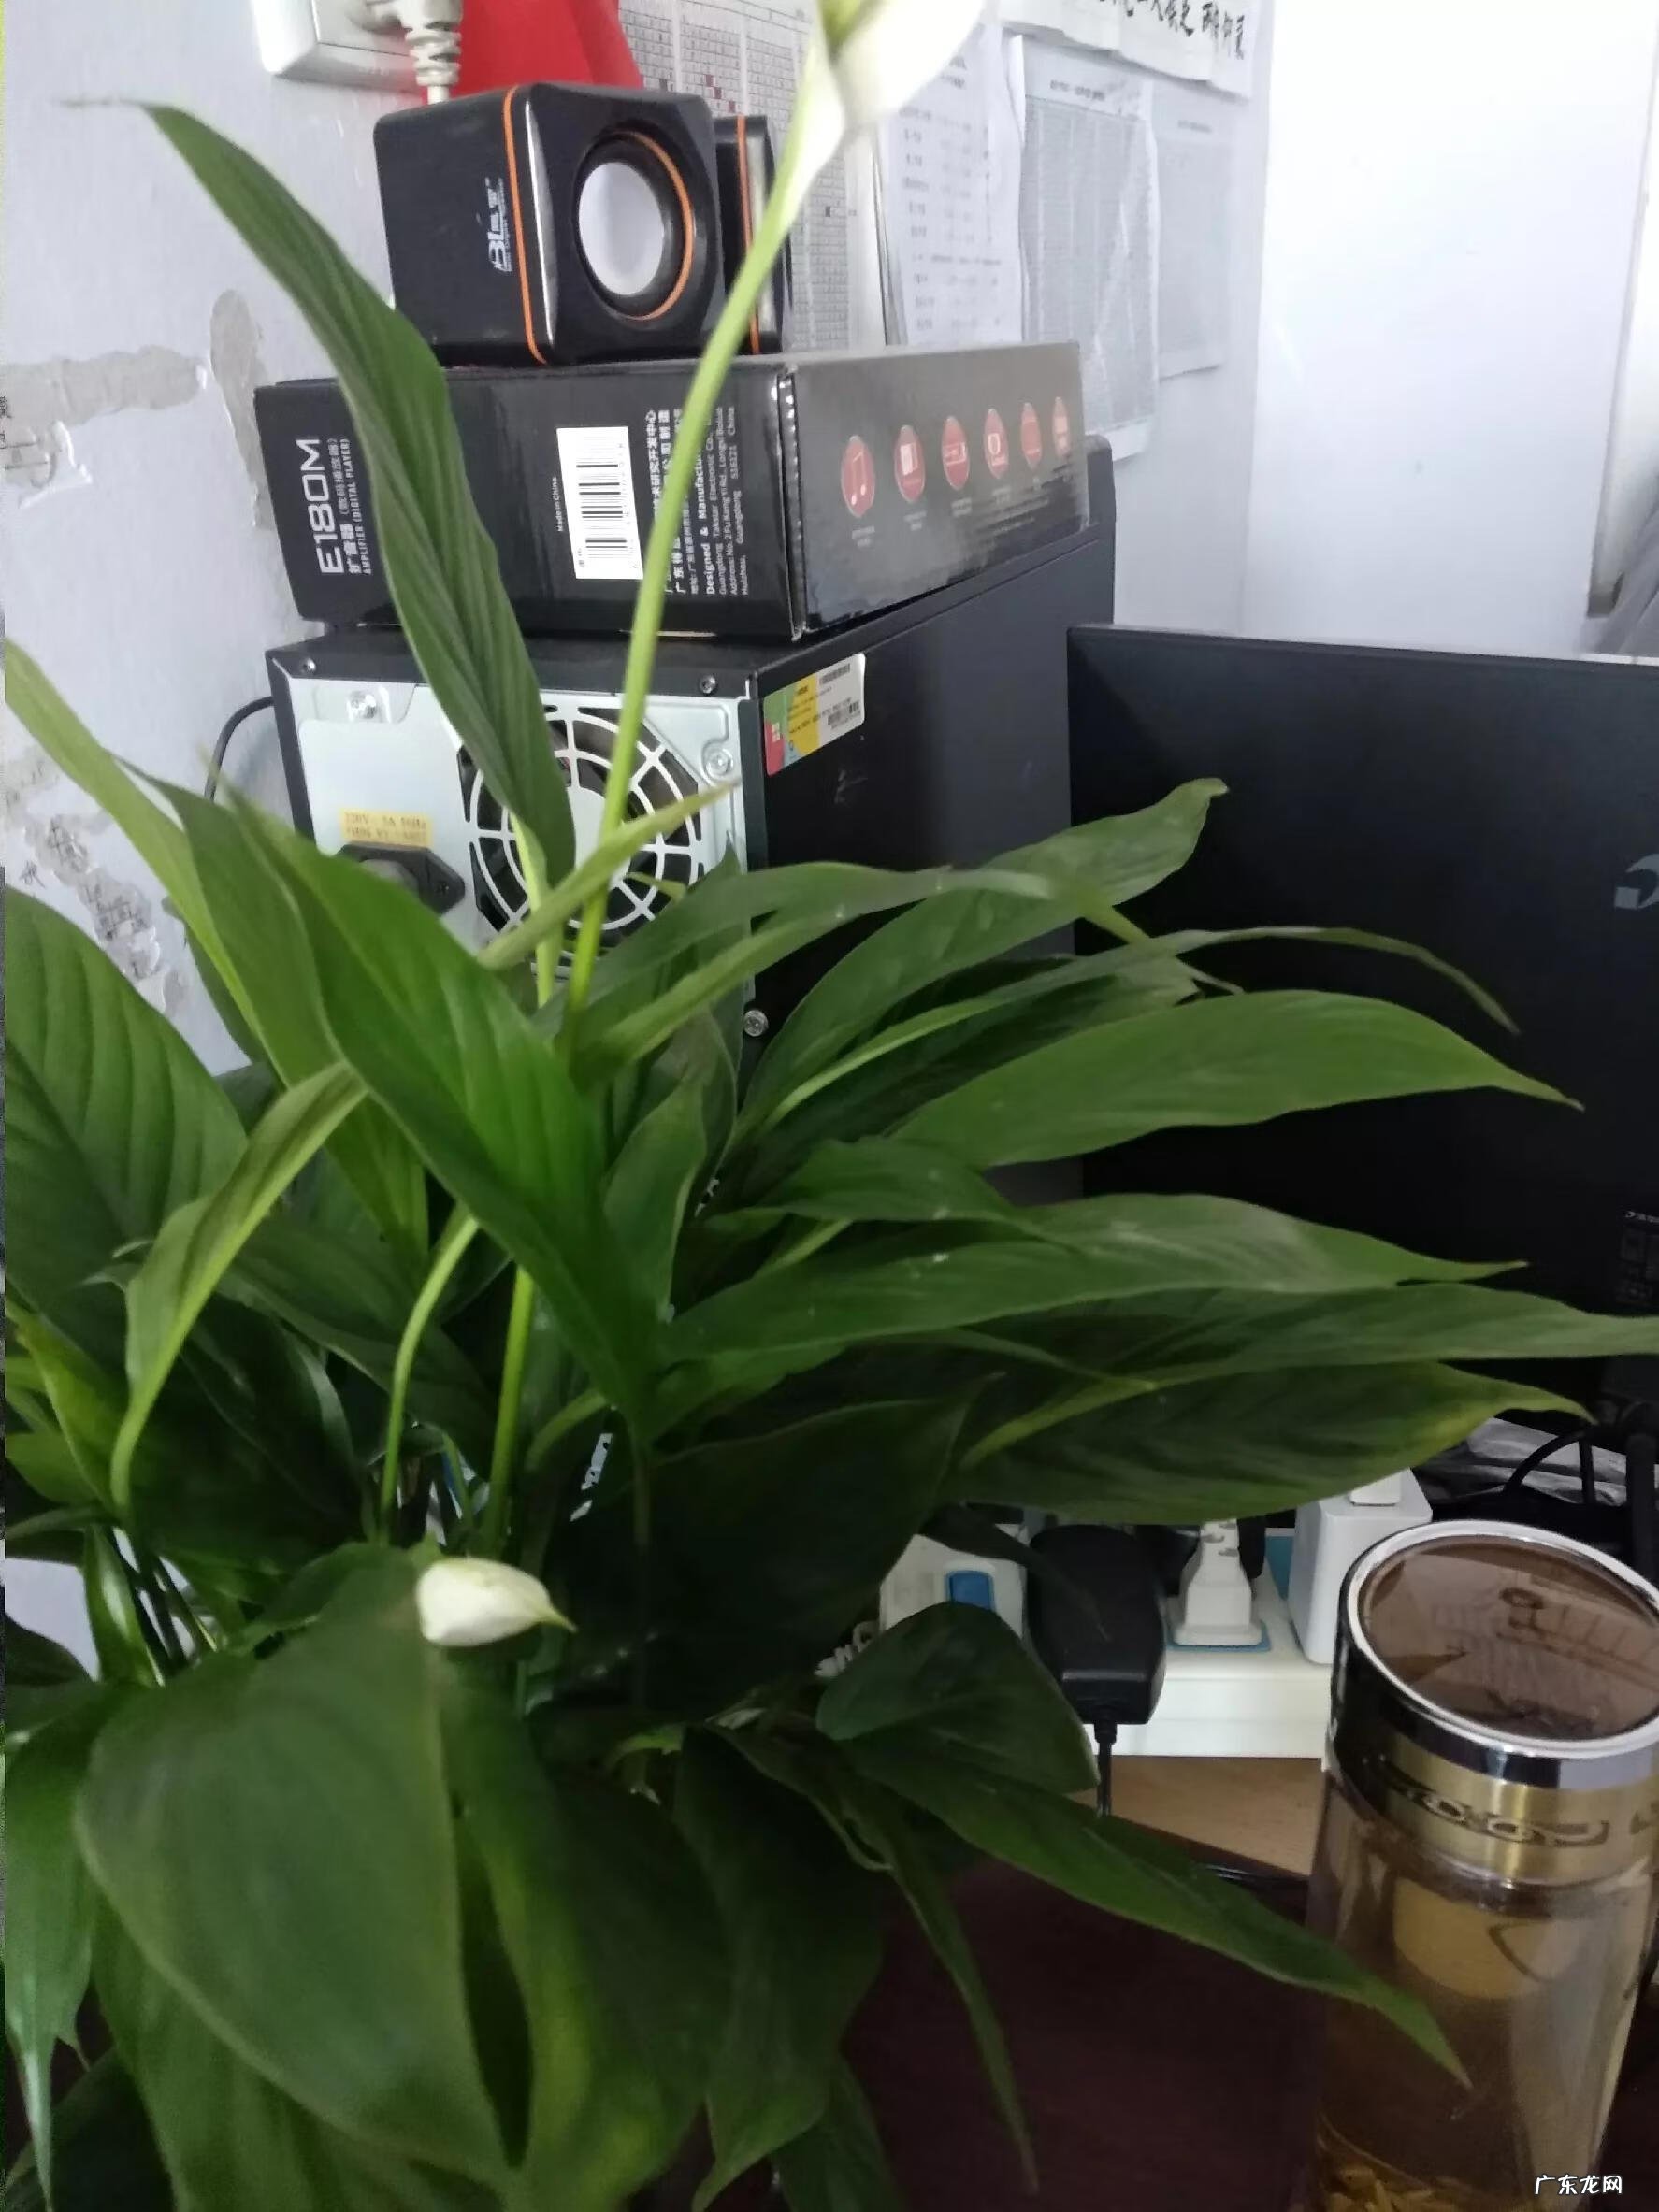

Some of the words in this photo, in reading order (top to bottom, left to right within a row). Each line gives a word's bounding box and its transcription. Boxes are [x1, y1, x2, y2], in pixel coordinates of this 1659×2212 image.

[727, 406, 735, 436] China
[339, 438, 353, 477] PLAYER)
[296, 438, 344, 572] E180M
[354, 526, 371, 574] AMPLIFIER
[700, 526, 708, 536] &
[700, 542, 715, 594] Designed
[715, 542, 726, 594] Guangdong
